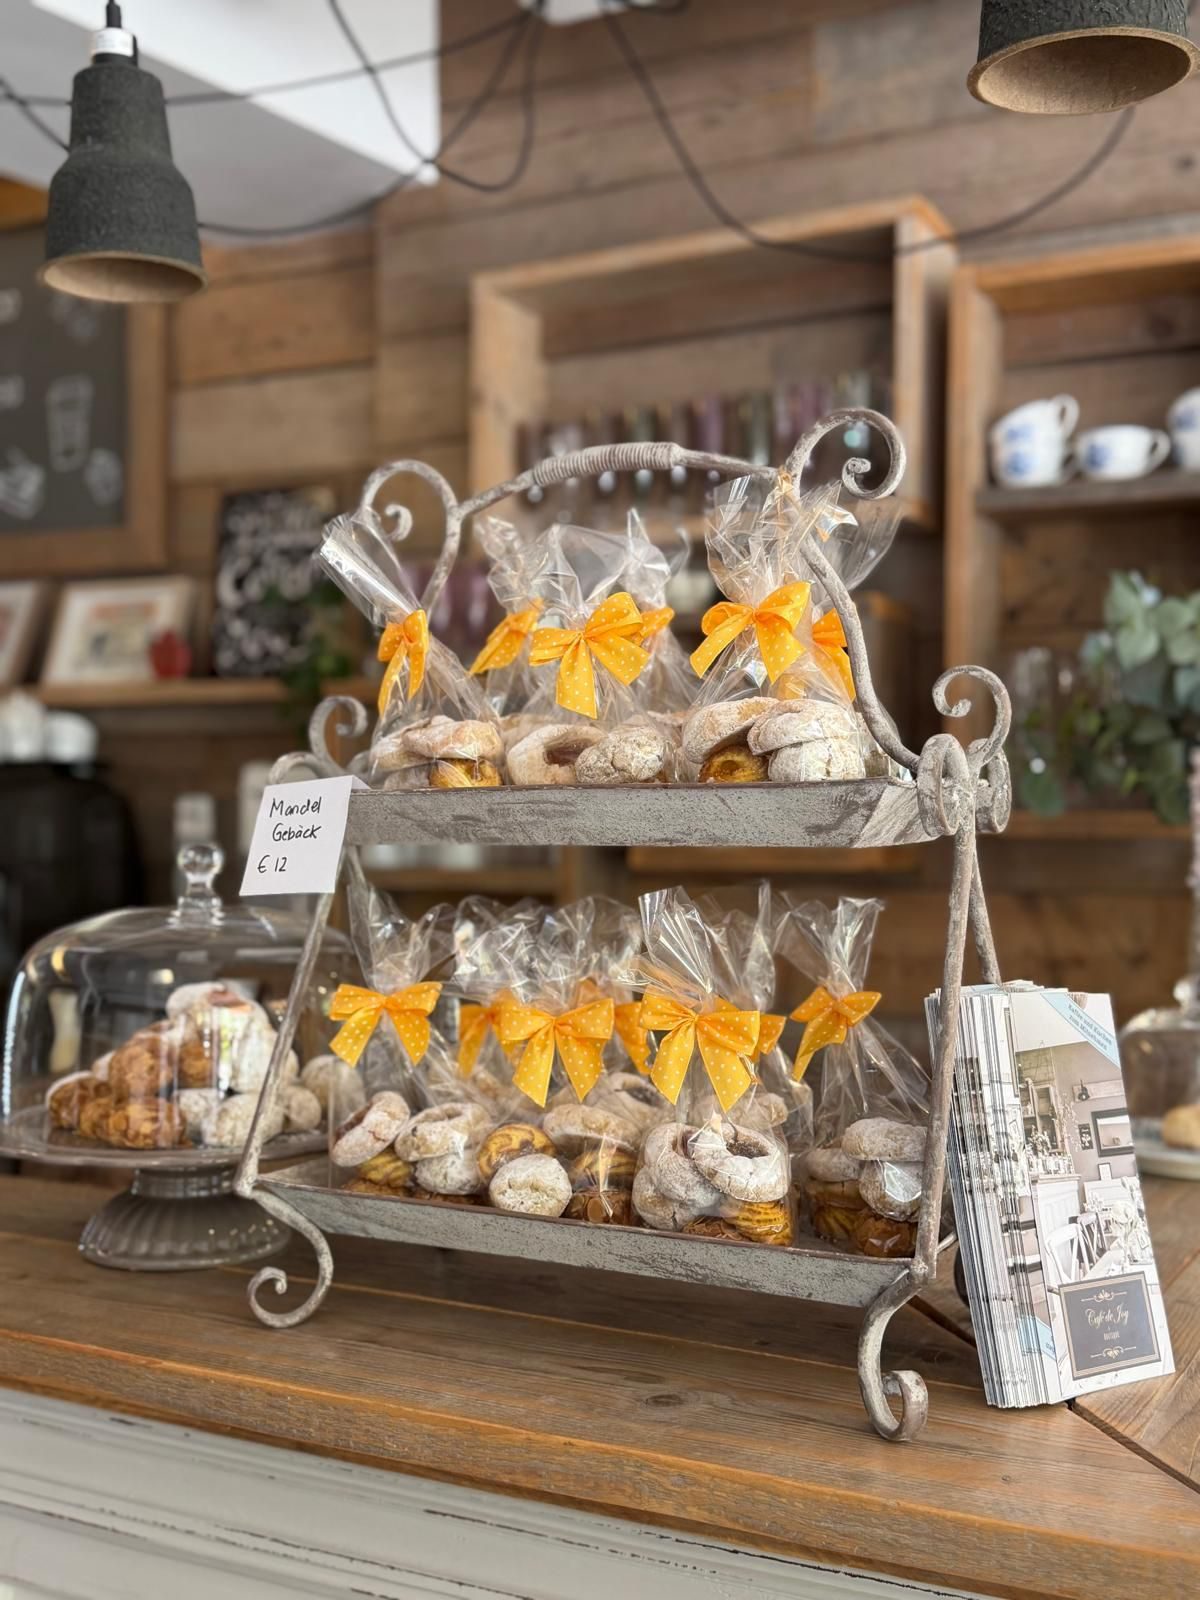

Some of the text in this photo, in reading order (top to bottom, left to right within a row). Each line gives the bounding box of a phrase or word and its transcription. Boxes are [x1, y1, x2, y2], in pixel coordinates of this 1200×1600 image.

[269, 795, 322, 818] Mandel
[272, 822, 321, 842] Gebäck
[1113, 1302, 1129, 1327] Joy
